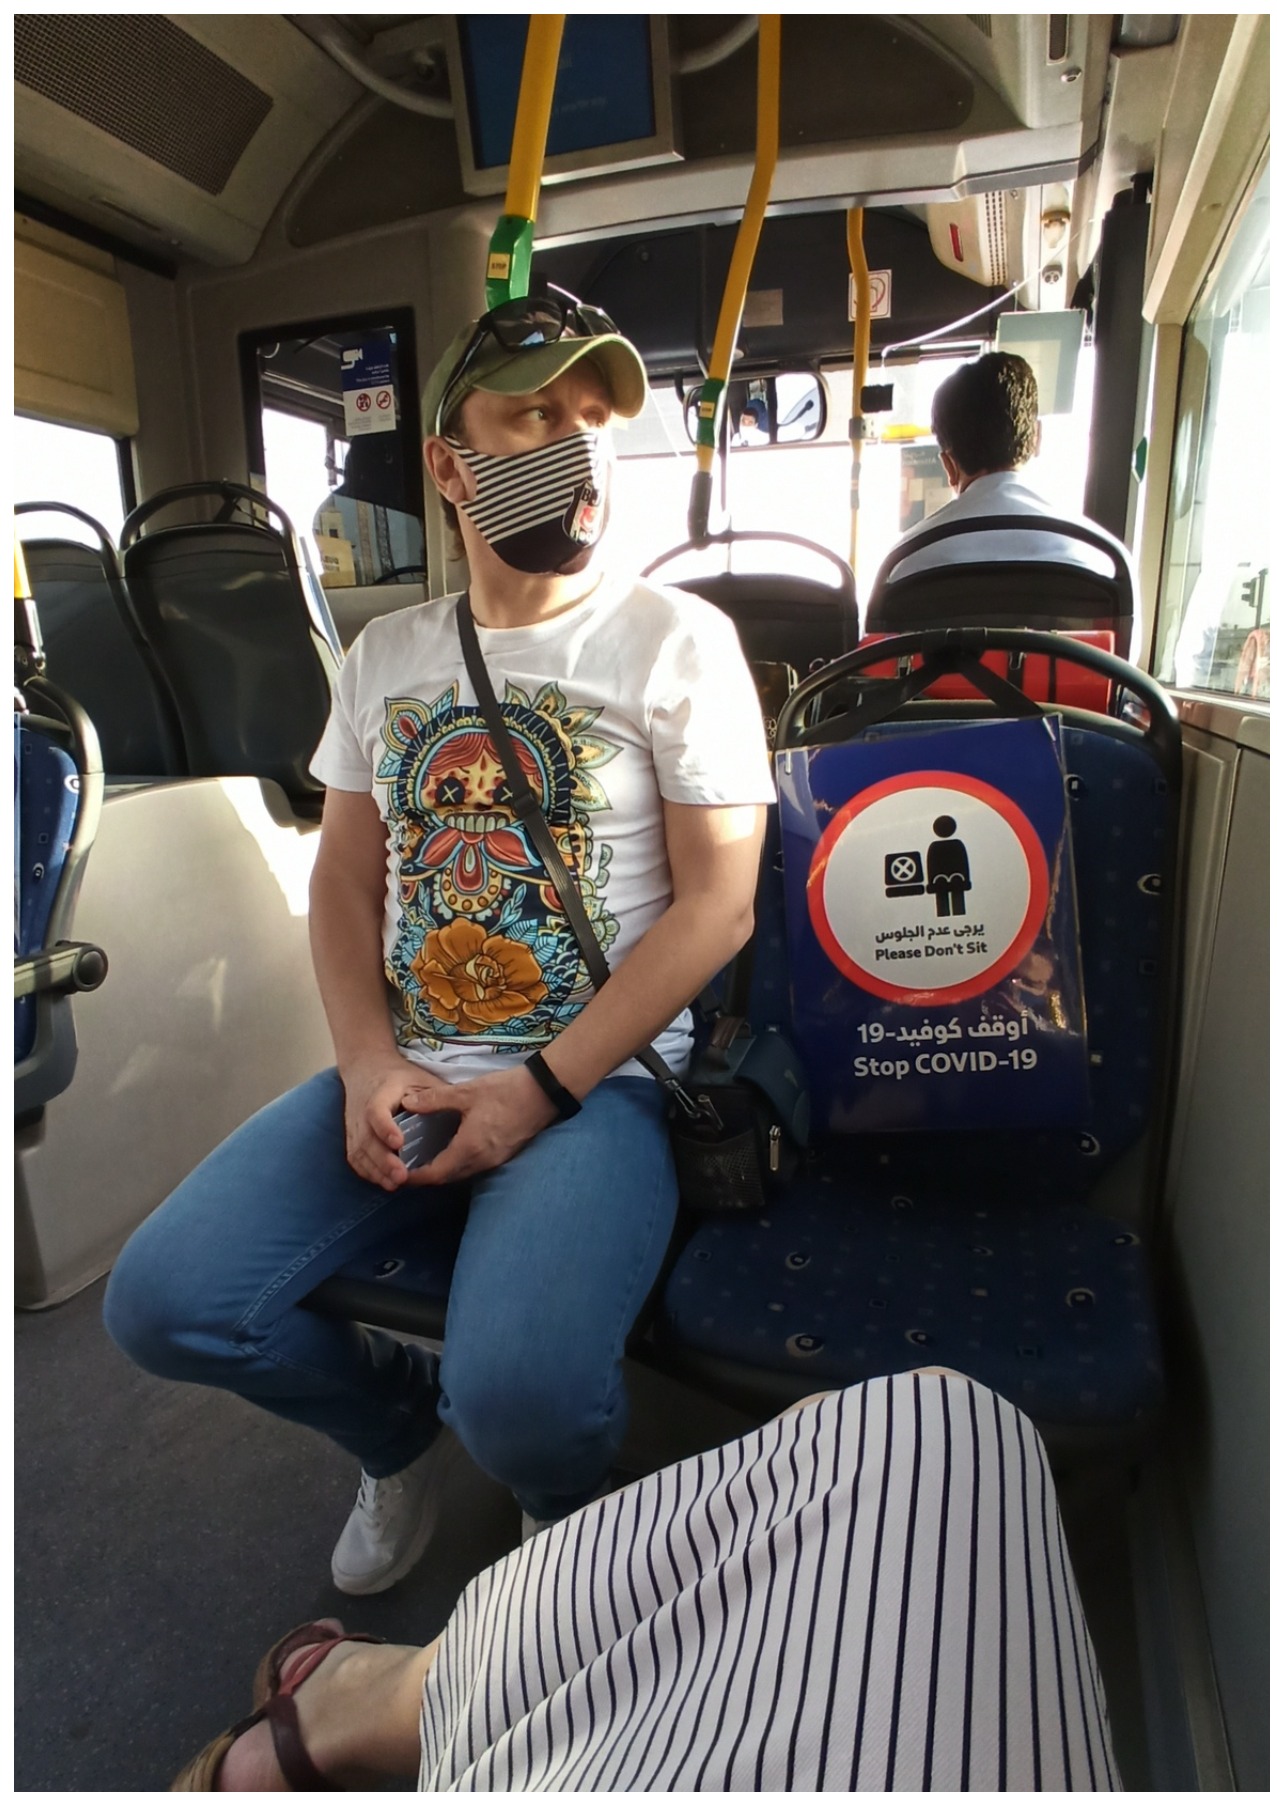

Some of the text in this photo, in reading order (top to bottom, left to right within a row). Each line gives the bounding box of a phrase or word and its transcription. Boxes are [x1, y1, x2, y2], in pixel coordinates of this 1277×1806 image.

[875, 923, 985, 943] يرجى عدم الجلوس
[875, 941, 988, 961] Please Don't Sit
[967, 1009, 1029, 1042] أوقف
[853, 1048, 1038, 1080] Stop COVID-19
